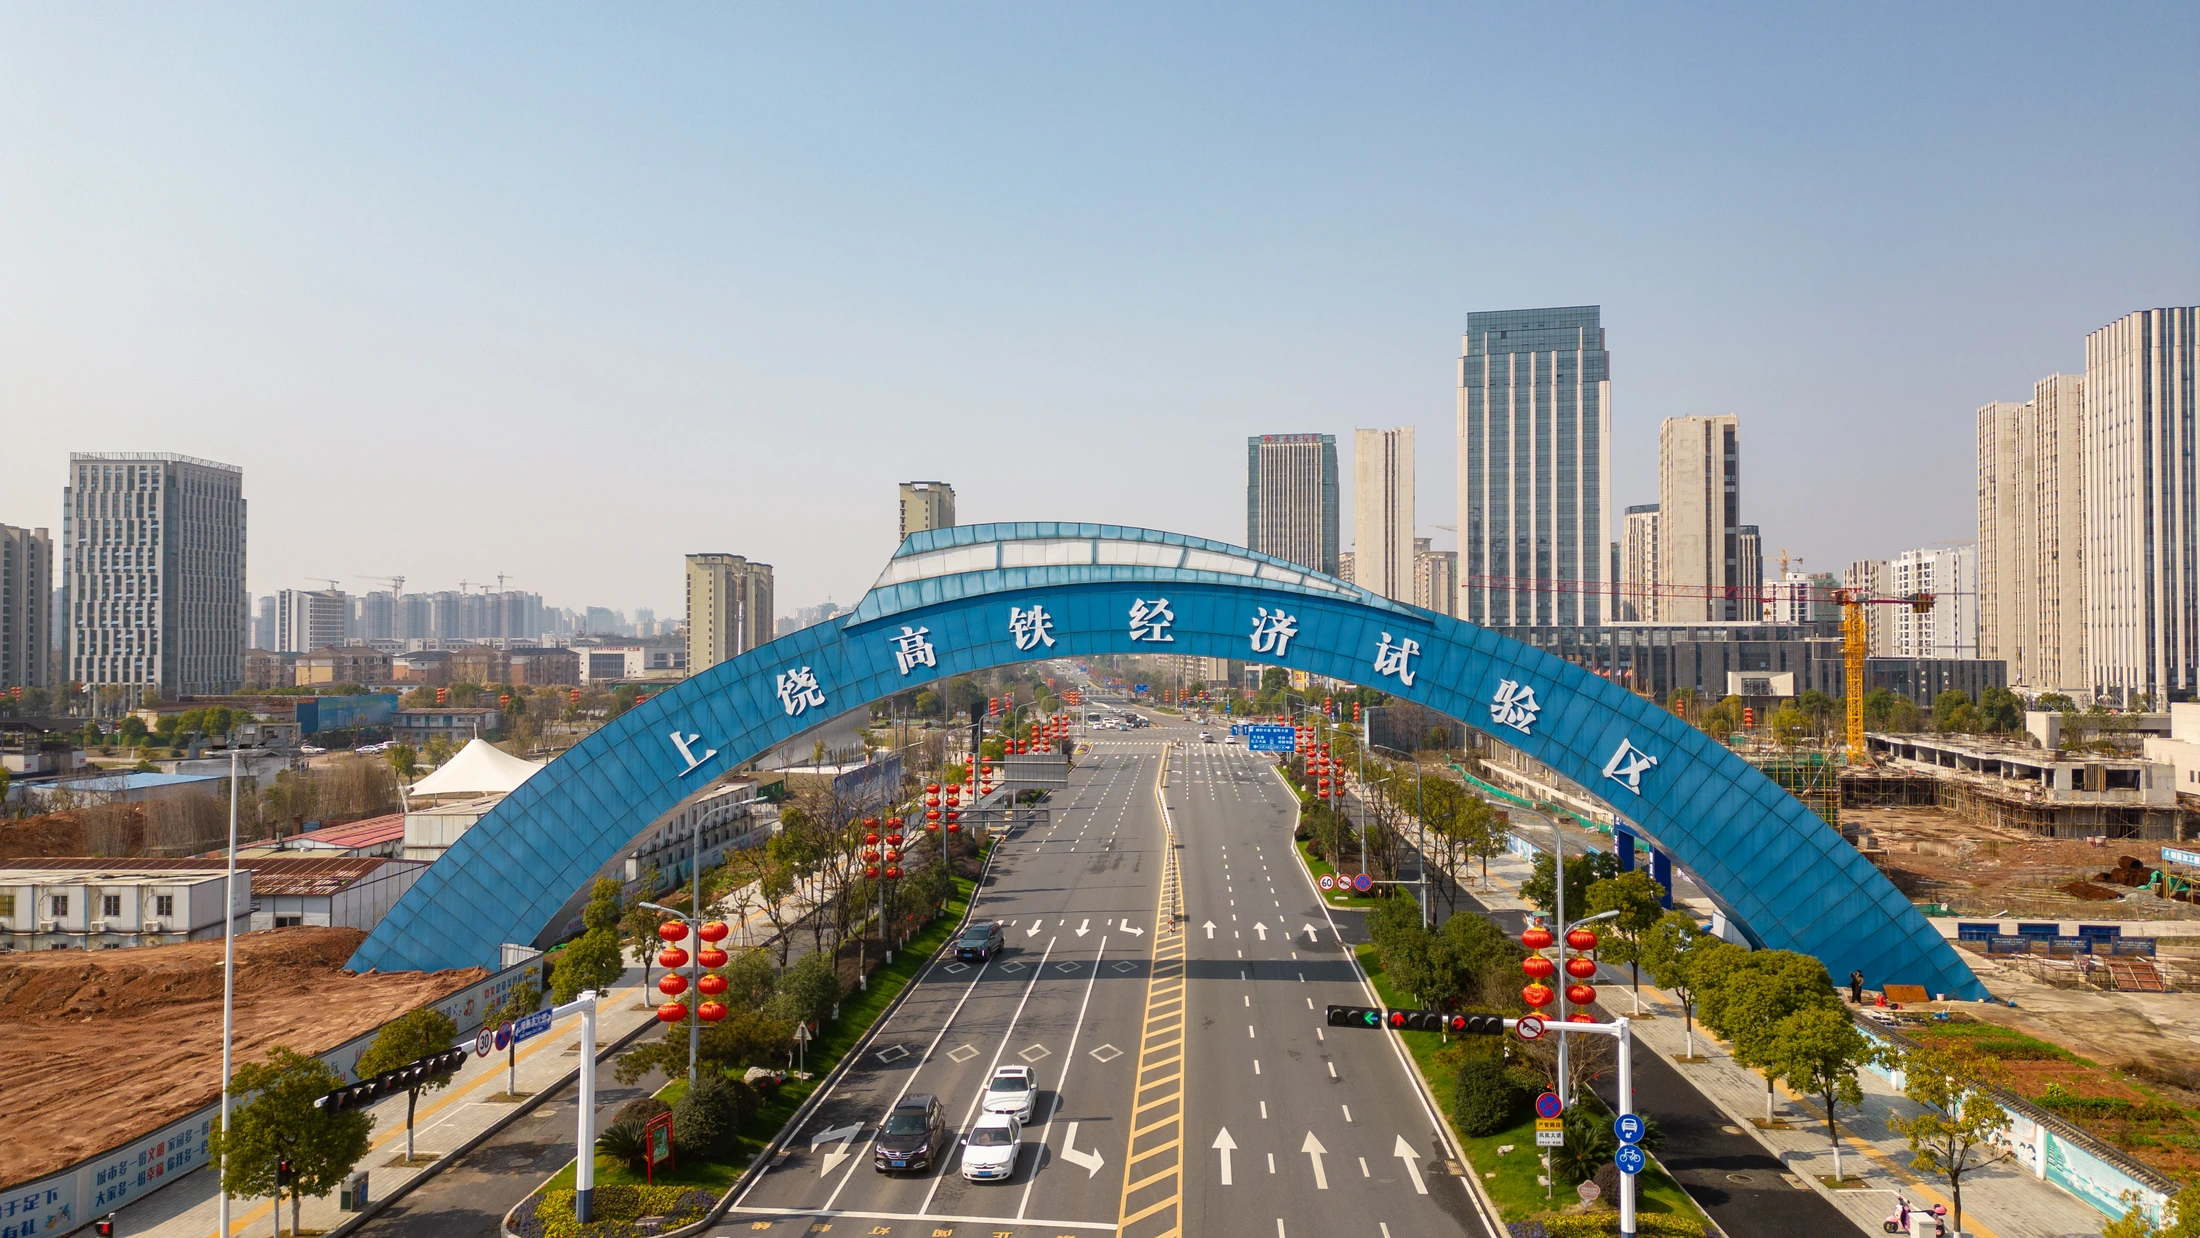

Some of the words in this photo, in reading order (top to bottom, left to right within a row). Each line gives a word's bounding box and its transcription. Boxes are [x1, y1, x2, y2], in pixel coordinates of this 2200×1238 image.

[670, 597, 1658, 796] 上饶高铁经济试验区
[1321, 878, 1332, 887] 60
[480, 1034, 489, 1050] 30
[96, 1161, 165, 1207] 大家多一份幸福
[97, 1142, 165, 1187] 城市多一份文明
